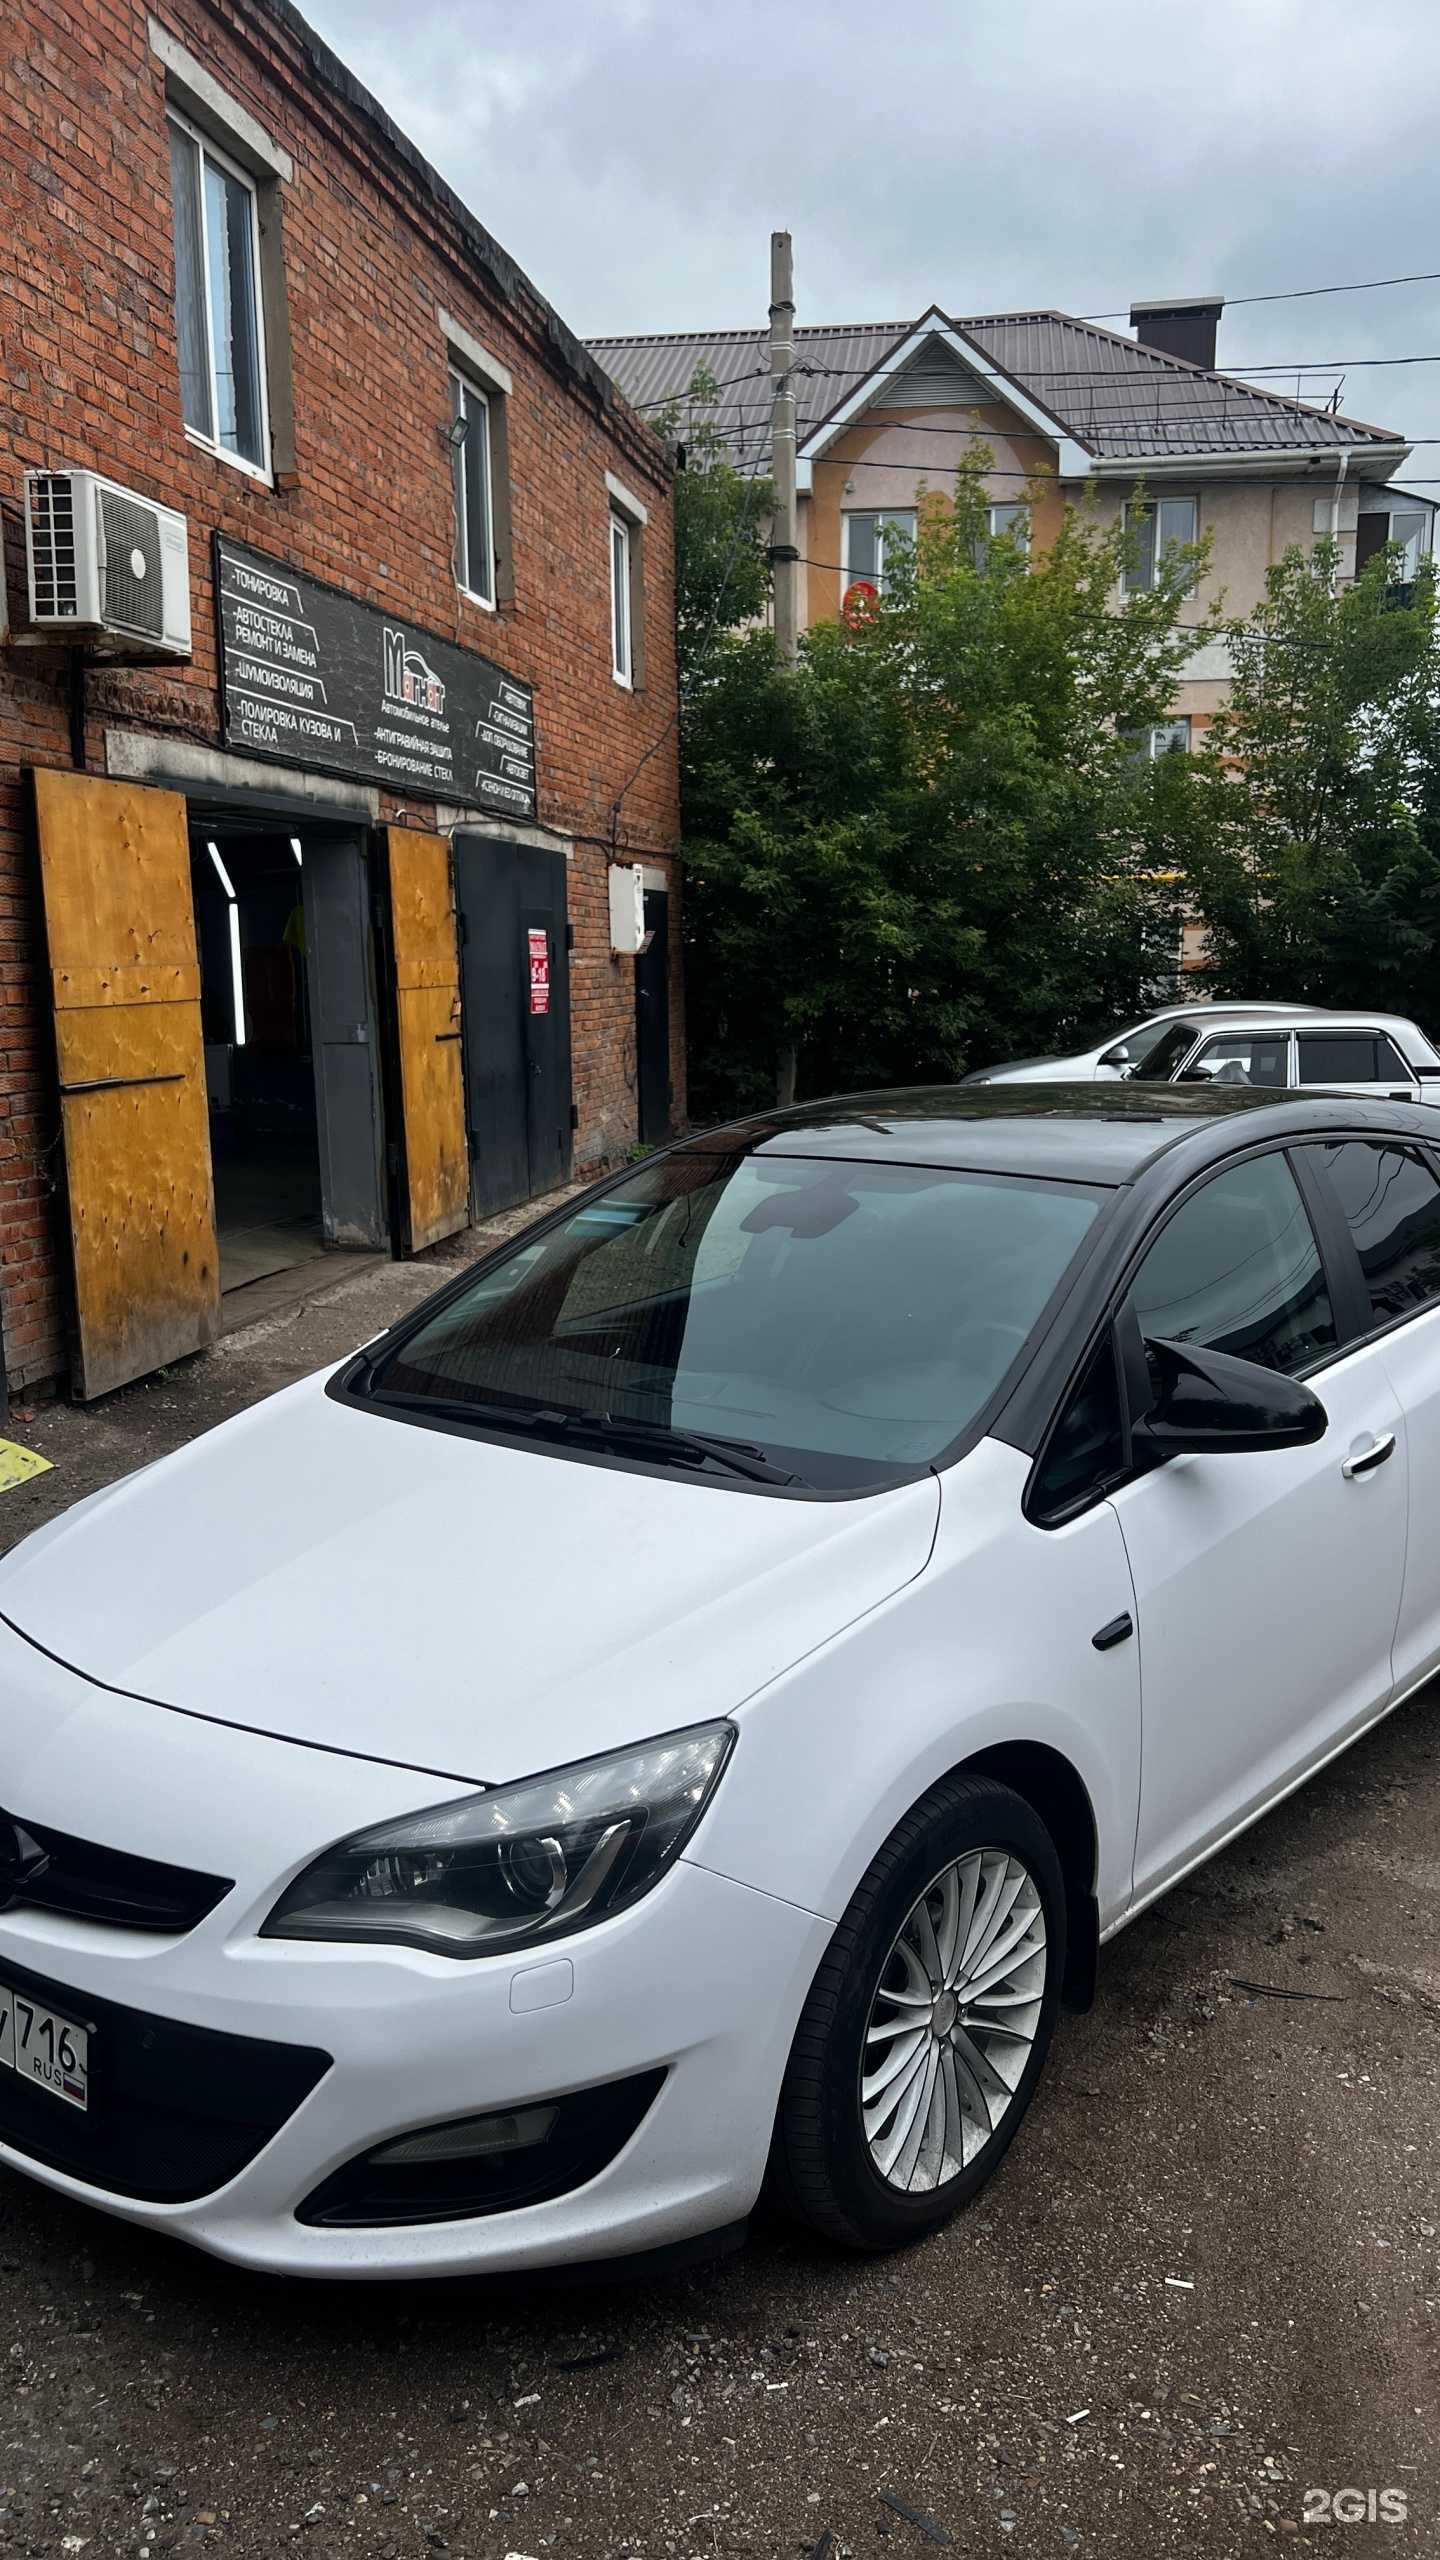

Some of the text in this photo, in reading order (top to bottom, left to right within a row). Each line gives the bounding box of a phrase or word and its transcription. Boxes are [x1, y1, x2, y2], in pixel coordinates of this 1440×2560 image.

[232, 568, 289, 607] -ТОНИРОВКА
[233, 606, 294, 642] -АВТОСТЕКЛА
[236, 624, 317, 668] РЕМОНТ И ЗАМЕНА
[234, 660, 314, 701] -ШУМОИЗОЛЯЦИЯ
[237, 699, 342, 742] -ПОЛИРОВКА КУЗОВА И
[241, 719, 279, 743] СТЕКЛА
[16, 2000, 77, 2073] 716
[33, 2057, 62, 2086] RUS
